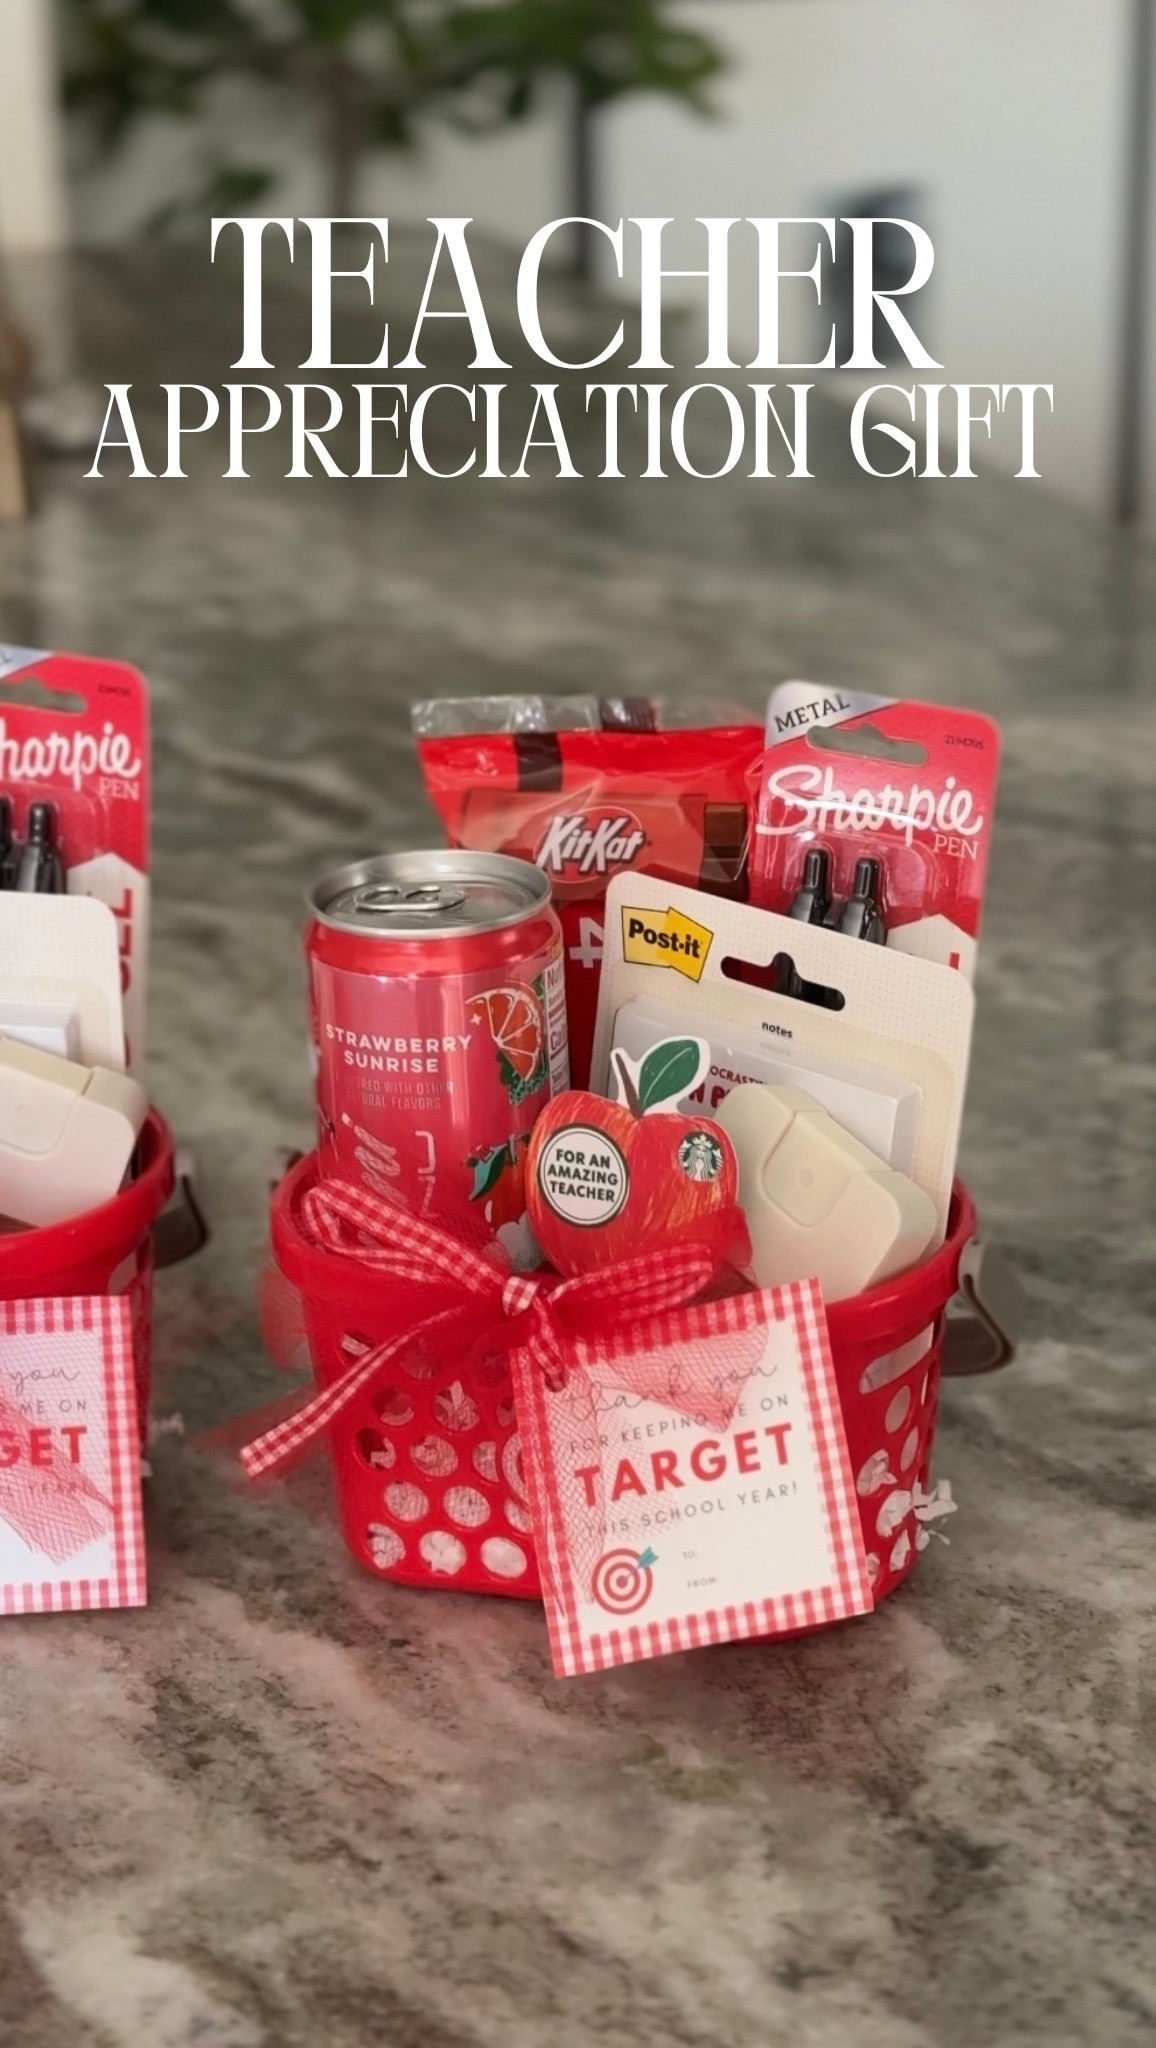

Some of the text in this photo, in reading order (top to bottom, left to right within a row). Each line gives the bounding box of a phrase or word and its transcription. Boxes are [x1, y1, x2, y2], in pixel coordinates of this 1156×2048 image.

[774, 693, 850, 733] METAL
[99, 776, 139, 800] PEN
[756, 764, 984, 848] Sharpie
[932, 833, 979, 860] PEN
[629, 917, 700, 959] Post-it
[325, 1023, 472, 1053] STRAWBERRY
[762, 1022, 793, 1039] notes
[344, 1050, 439, 1073] SUNRISE
[384, 1081, 412, 1095] WITH
[391, 1096, 441, 1110] FLAVORS
[556, 1148, 610, 1169] FOR AN
[547, 1163, 618, 1186] AMAZING
[550, 1180, 615, 1202] TEACHER
[709, 1364, 778, 1401] you
[59, 1400, 87, 1413] ON
[570, 1393, 789, 1454] FOR KEEPING ME ON
[574, 1422, 794, 1508] TARGET
[641, 1498, 726, 1527] SCHOOL
[738, 1481, 798, 1506] YEAR!
